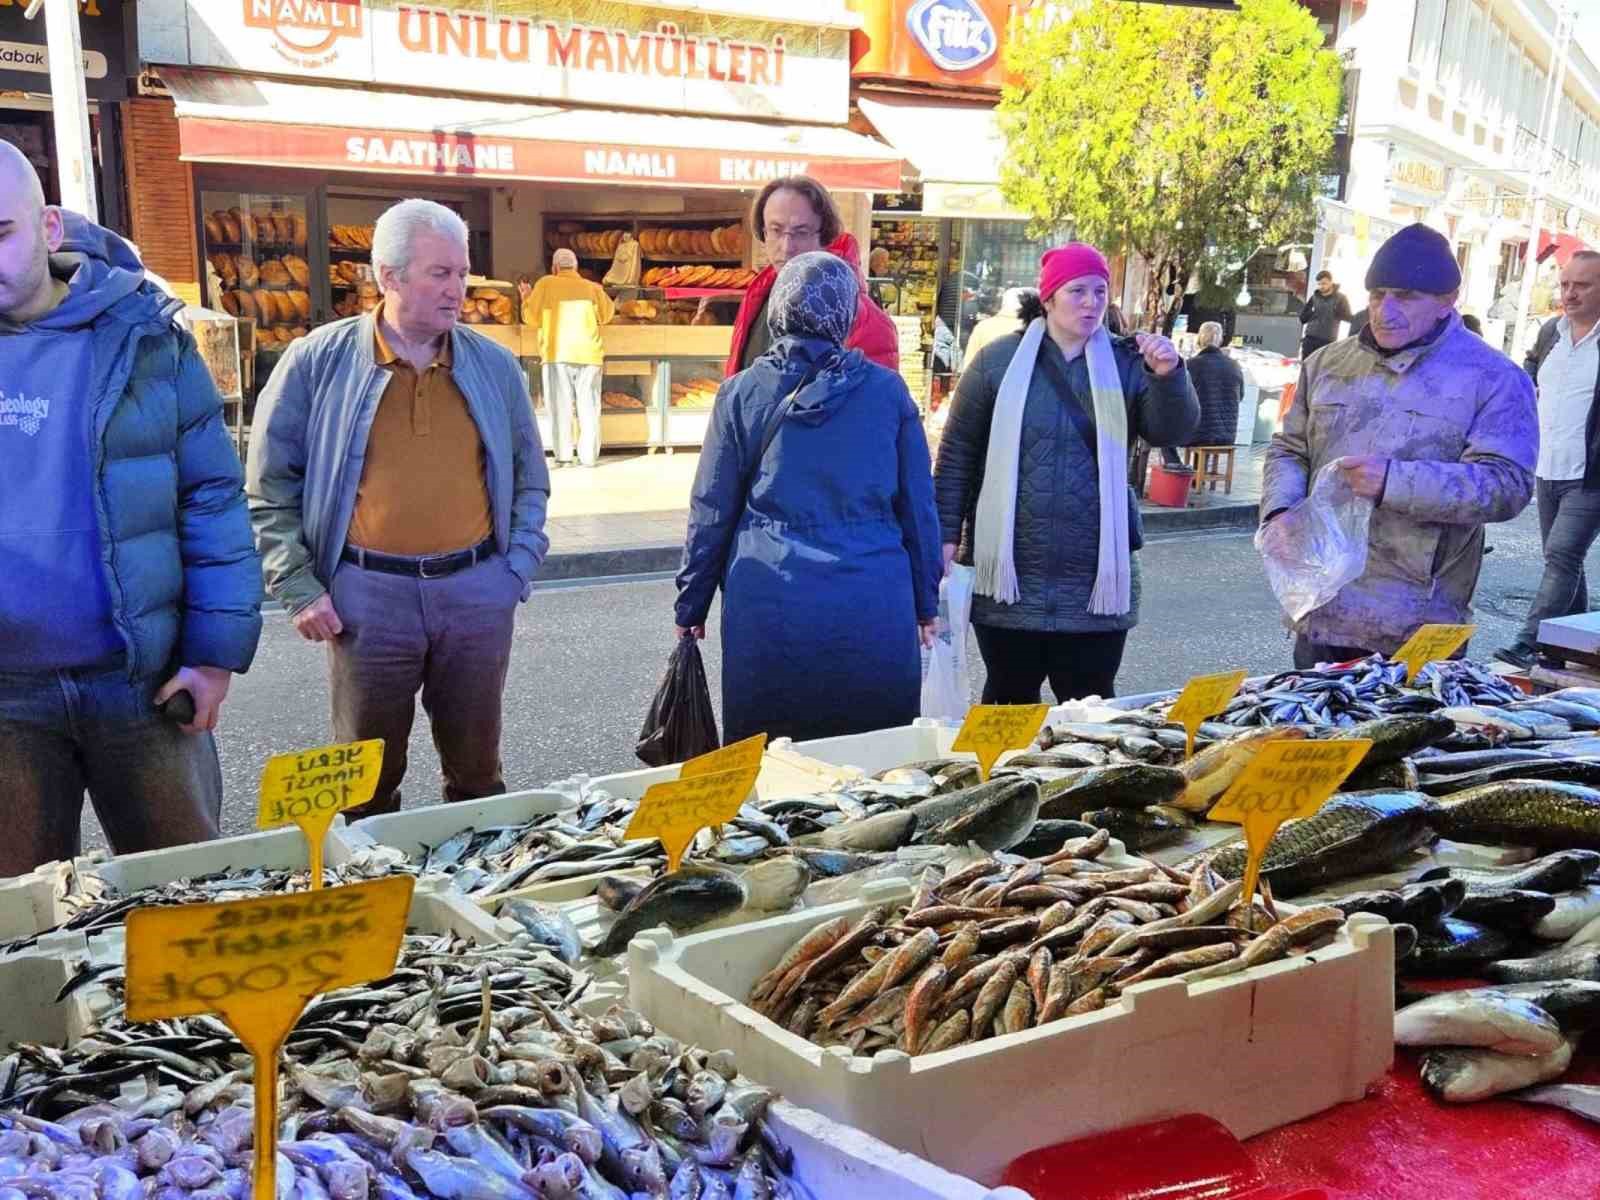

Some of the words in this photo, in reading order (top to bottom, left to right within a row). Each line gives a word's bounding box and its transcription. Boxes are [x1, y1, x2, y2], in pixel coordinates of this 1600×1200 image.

[251, 0, 357, 28] NAMLI
[398, 7, 529, 63] UNLU
[546, 24, 785, 85] MAMÜLLERİ
[346, 136, 514, 170] SAATHANE
[584, 149, 677, 178] NAMLI
